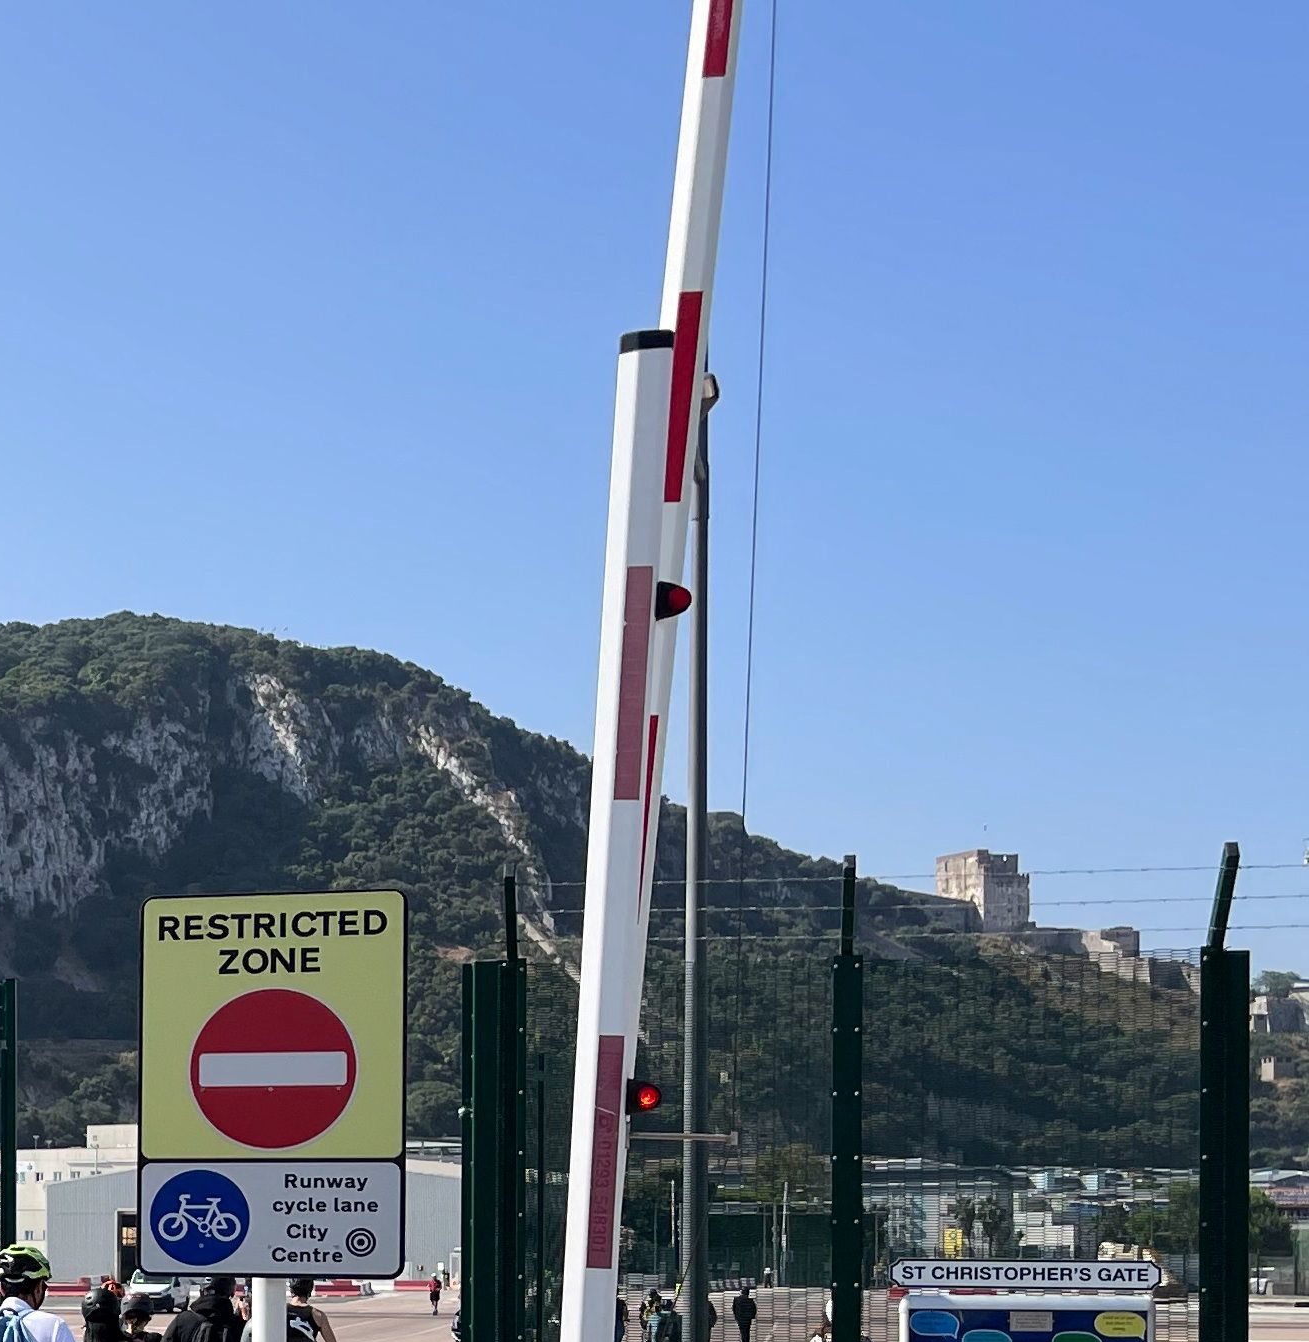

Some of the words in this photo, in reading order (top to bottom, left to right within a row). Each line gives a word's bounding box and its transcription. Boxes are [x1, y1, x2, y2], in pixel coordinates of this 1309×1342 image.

[158, 909, 388, 942] RESTRICTED
[218, 947, 321, 975] ZONE
[284, 1173, 368, 1191] Runway
[272, 1197, 327, 1215] cycle
[333, 1197, 379, 1212] lane
[286, 1223, 328, 1241] City
[271, 1246, 343, 1262] Centre
[901, 1265, 926, 1280] ST
[931, 1266, 1092, 1281] CHRISTOPHER'S
[1097, 1267, 1149, 1282] GATE
